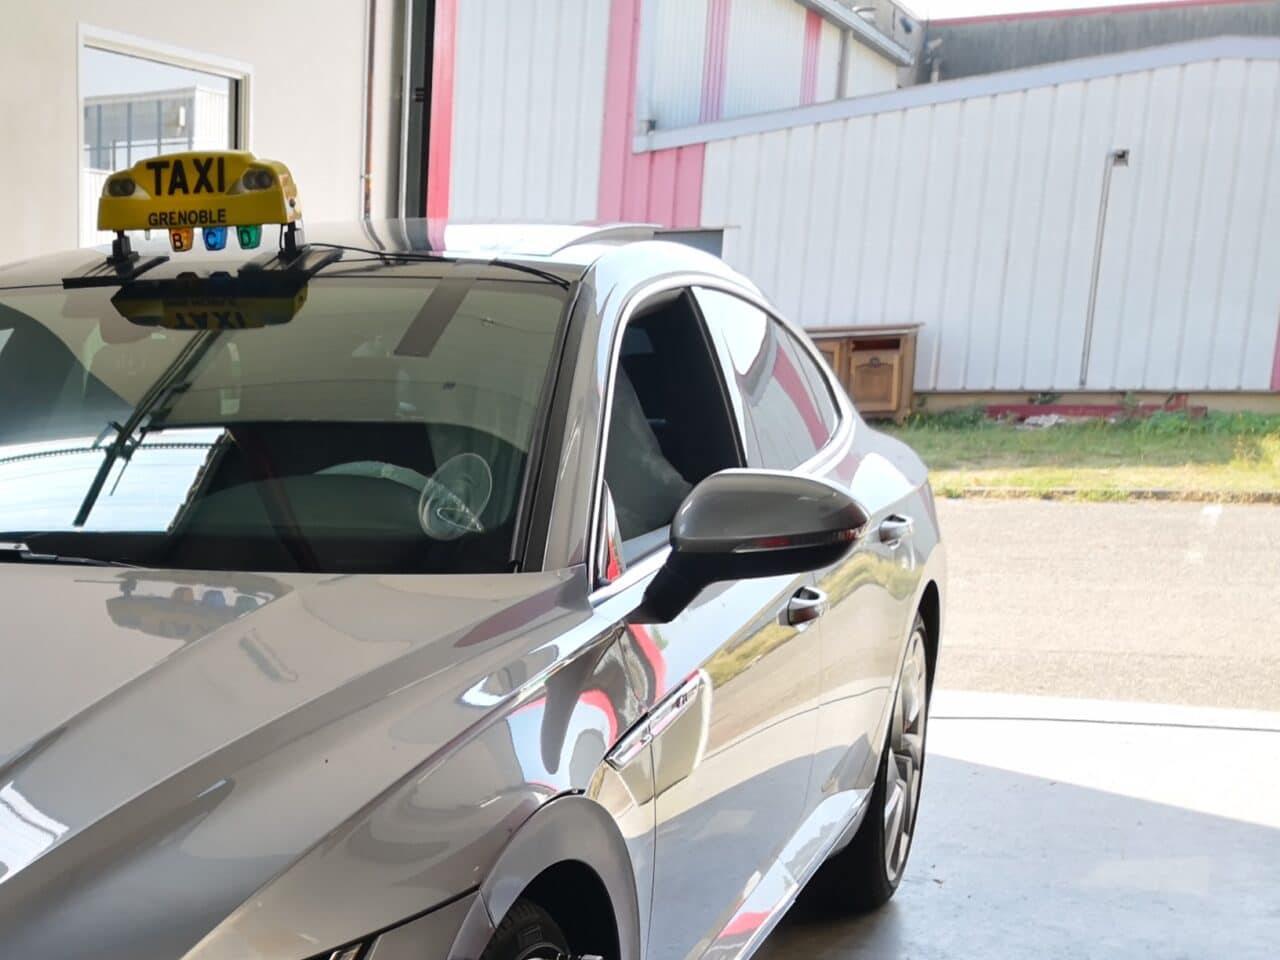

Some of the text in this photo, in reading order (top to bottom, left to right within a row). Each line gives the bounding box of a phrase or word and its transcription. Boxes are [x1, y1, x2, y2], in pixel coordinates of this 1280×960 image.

[147, 157, 225, 195] TAXI
[148, 209, 227, 226] GRENOBLE
[172, 230, 252, 250] B C D
